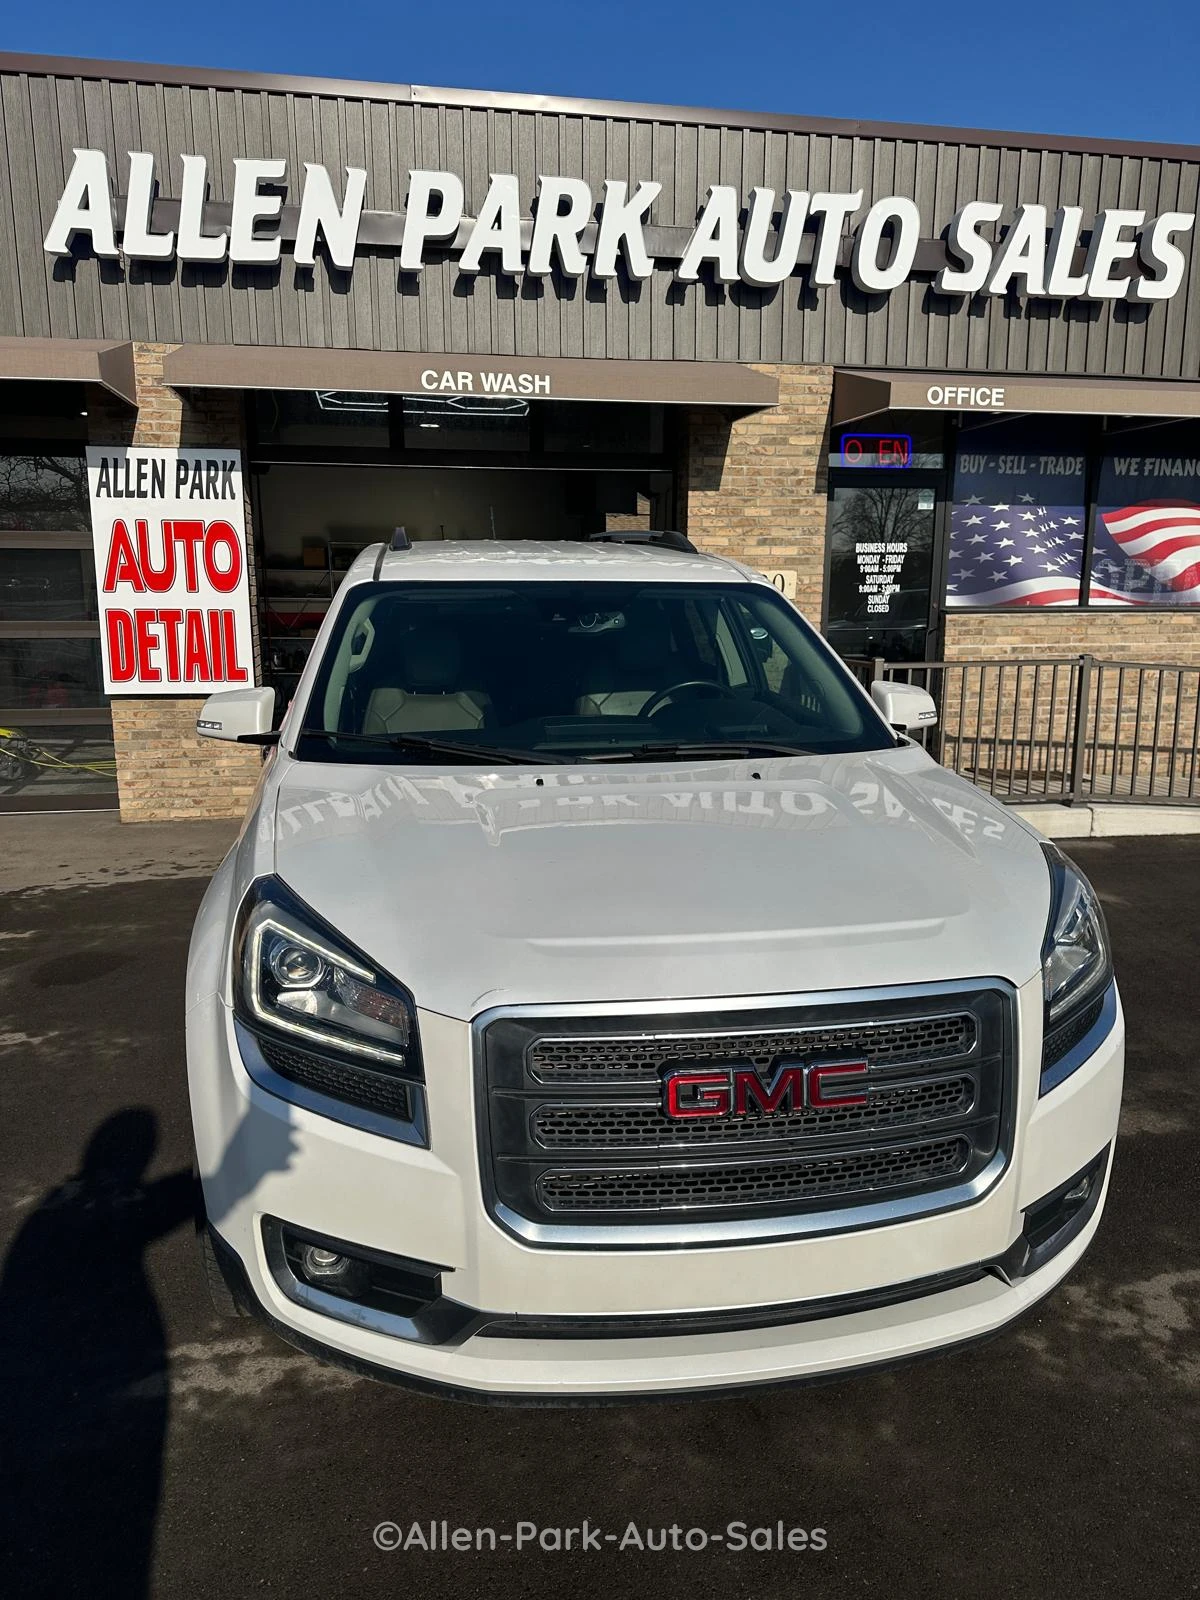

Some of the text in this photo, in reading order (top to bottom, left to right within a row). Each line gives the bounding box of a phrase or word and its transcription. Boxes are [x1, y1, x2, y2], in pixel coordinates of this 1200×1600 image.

[44, 148, 1195, 302] ALLEN PARK AUTO SALES
[421, 370, 550, 394] CAR WASH
[926, 386, 1005, 407] OFFICE
[960, 455, 985, 474] BUY
[998, 456, 1027, 475] SELL
[1039, 456, 1084, 475] TRADE
[1114, 457, 1140, 476] WE
[96, 457, 236, 500] ALLEN PARK
[103, 519, 242, 593] AUTO
[856, 543, 908, 553] BUSINESS HOURS
[857, 555, 880, 564] MONDAY
[866, 575, 894, 584] SATURDAY
[867, 605, 889, 613] CLOSED
[868, 595, 890, 604] SUNDAY
[105, 608, 248, 682] DETAIL
[664, 1059, 869, 1118] GMC
